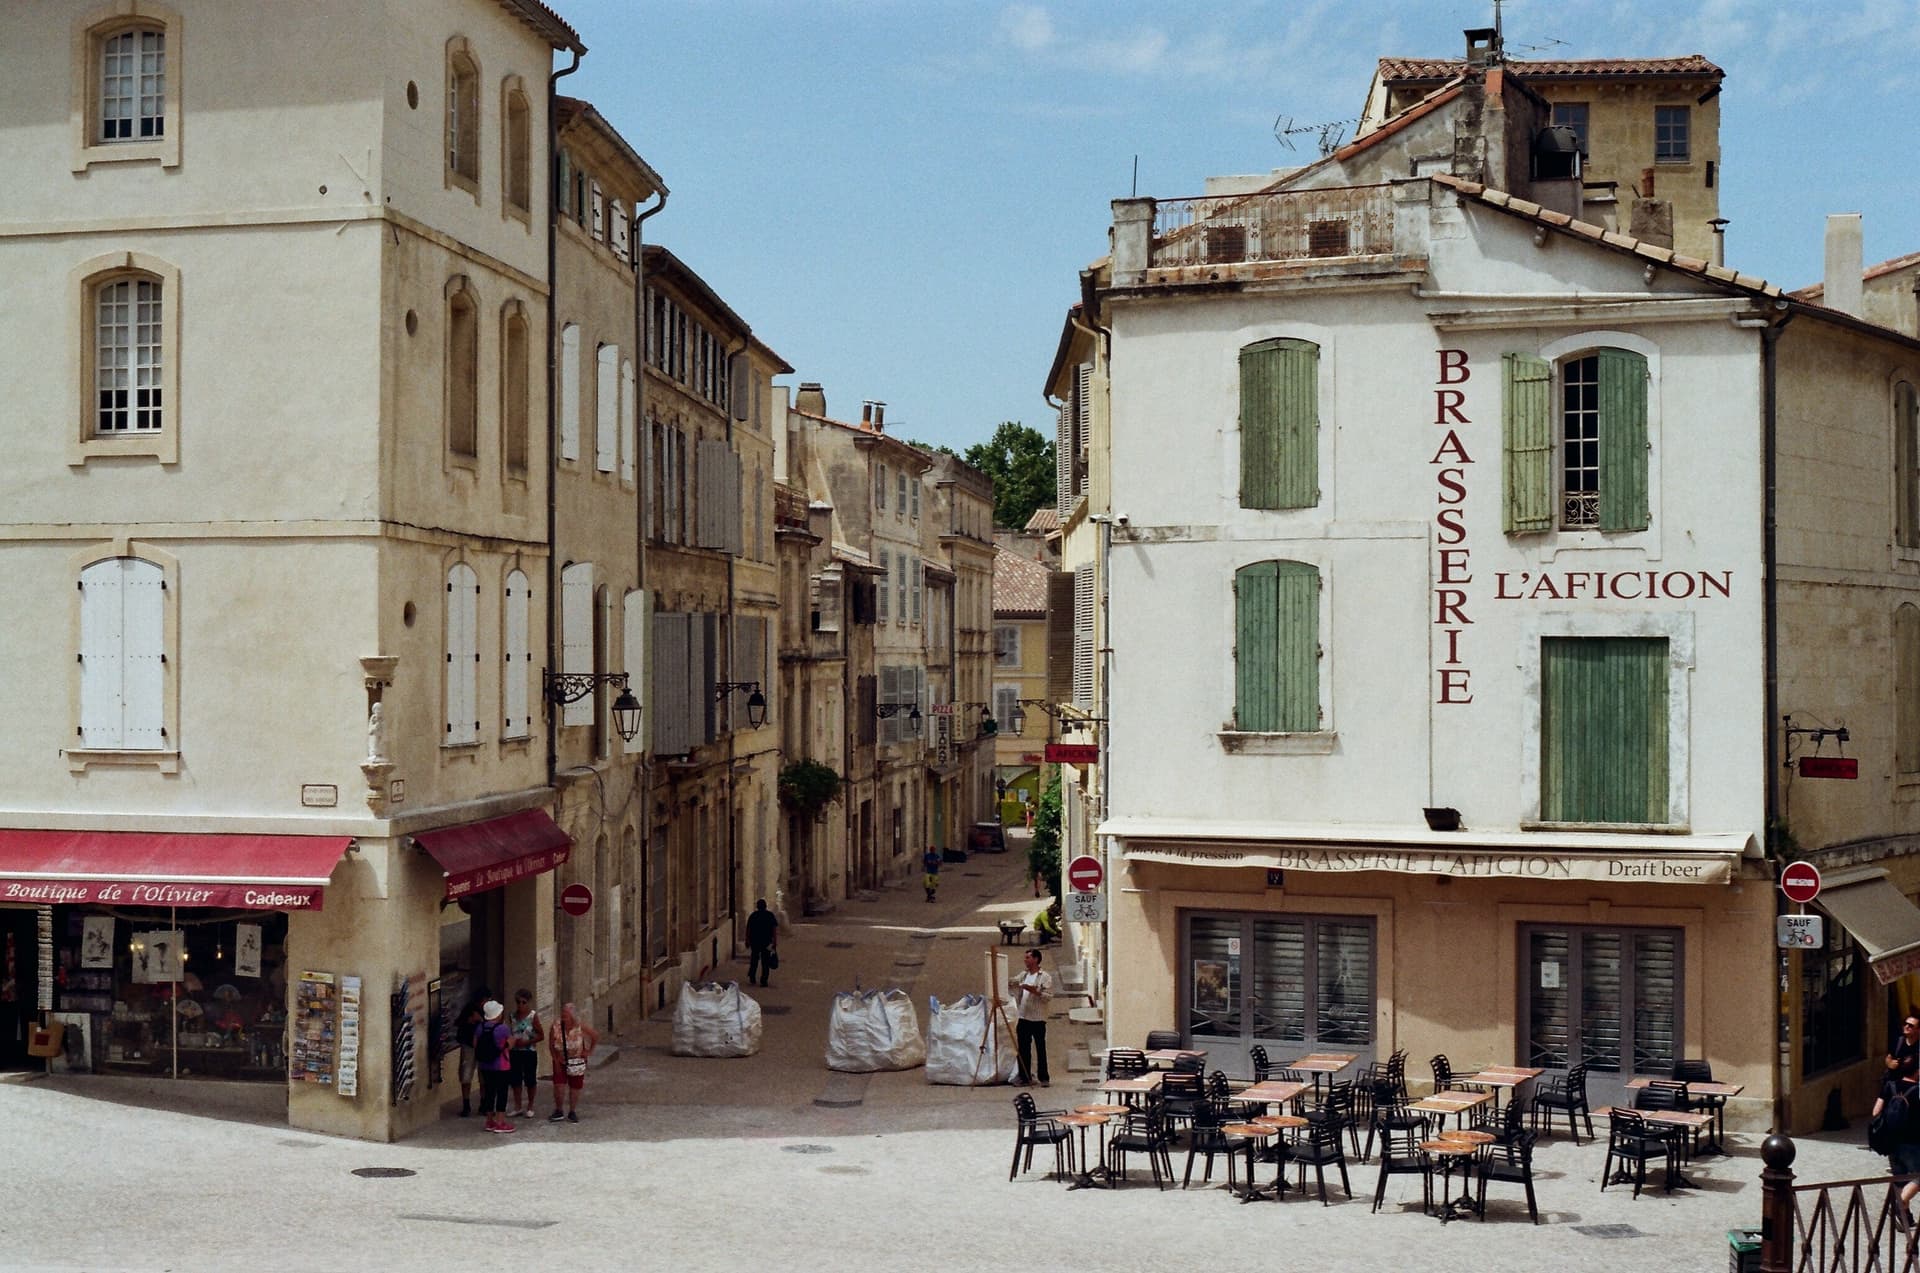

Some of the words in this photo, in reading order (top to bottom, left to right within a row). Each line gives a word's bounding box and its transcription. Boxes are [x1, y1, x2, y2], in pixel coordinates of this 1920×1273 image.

[1429, 349, 1475, 704] BRASSERIE
[1494, 571, 1733, 600] L'AFICION
[932, 704, 953, 713] PIZZA
[1190, 850, 1244, 861] pression
[1278, 850, 1417, 871] BRASSERIE
[1429, 854, 1572, 878] L'AFICION
[1608, 860, 1655, 878] Draft
[1662, 860, 1702, 878] beer
[5, 883, 88, 903] Boutique
[98, 884, 122, 900] de
[132, 884, 214, 903] l'Olivier
[245, 890, 311, 906] Cadeaux
[1074, 895, 1097, 903] SAUF
[1787, 919, 1811, 928] SAUF
